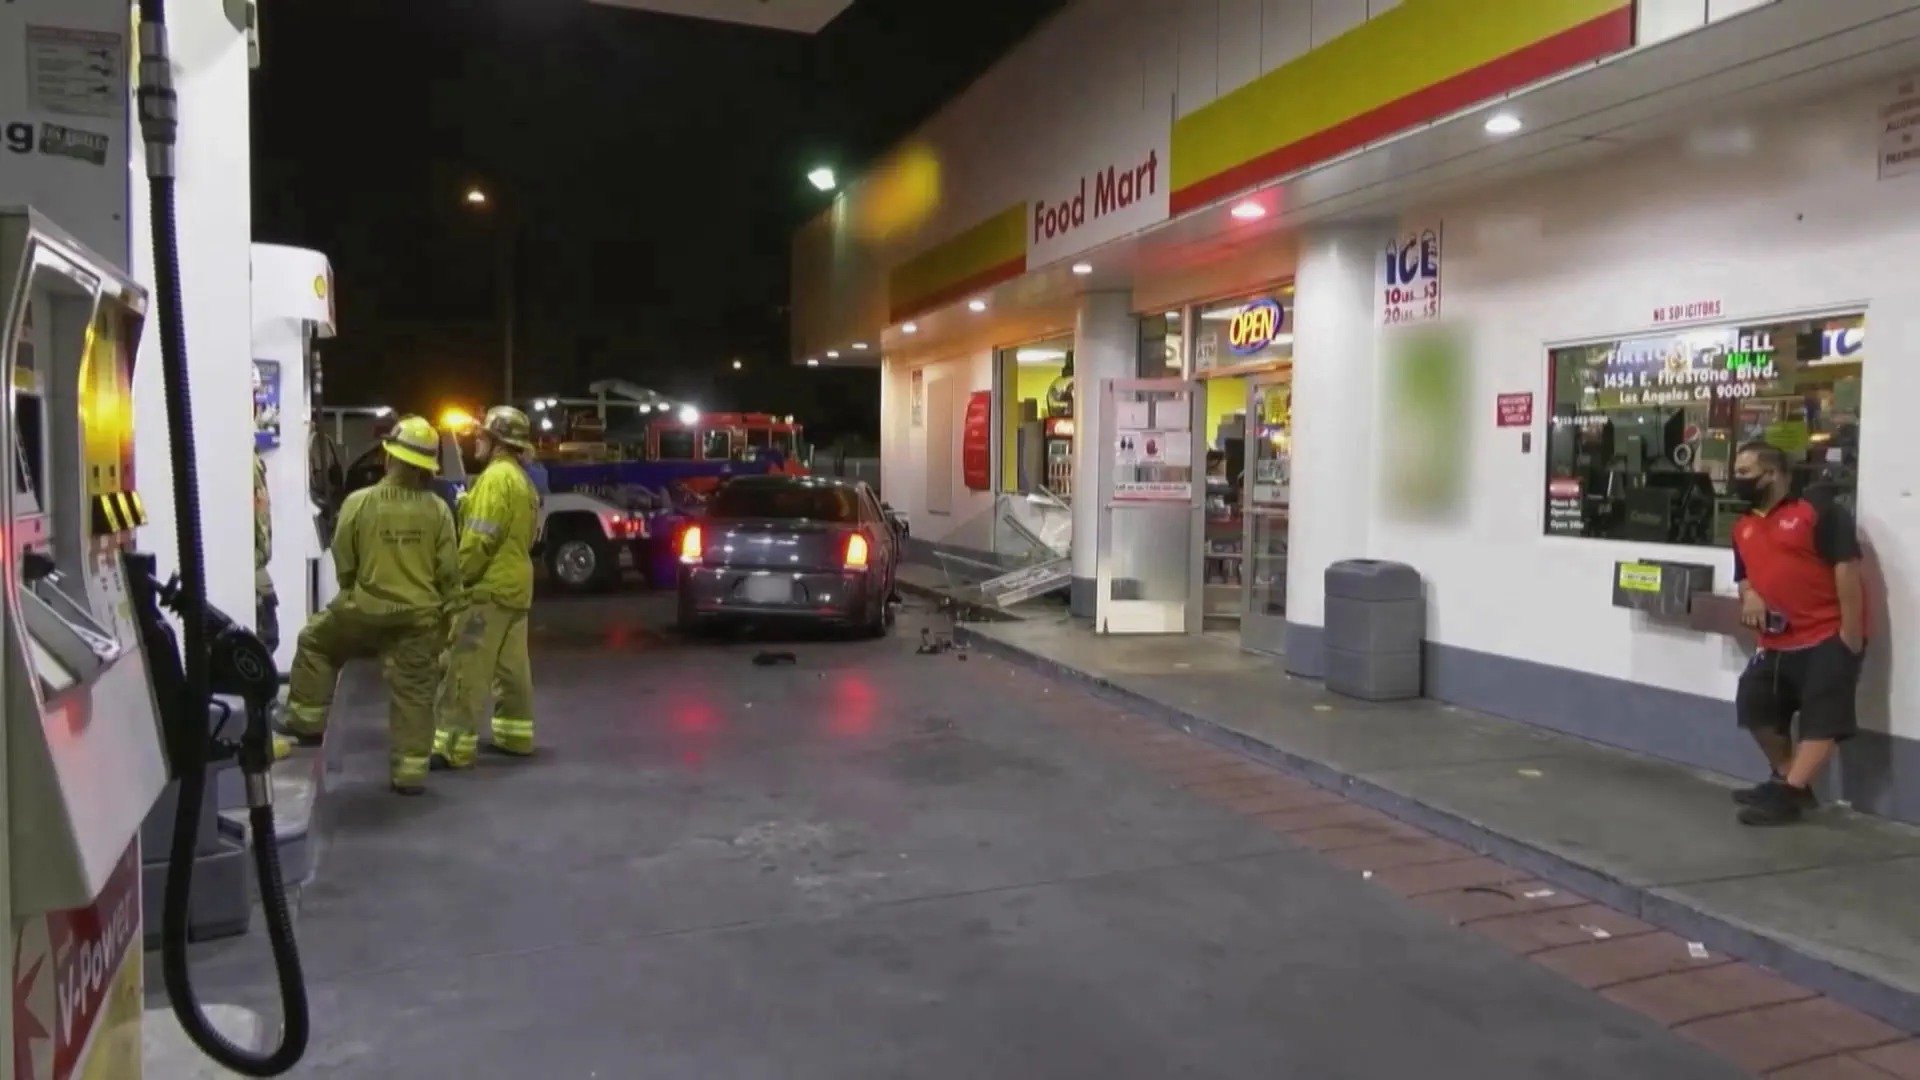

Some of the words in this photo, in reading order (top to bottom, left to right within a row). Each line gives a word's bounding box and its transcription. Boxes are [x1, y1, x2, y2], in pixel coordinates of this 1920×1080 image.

[0, 121, 34, 154] g
[1034, 176, 1085, 244] Food
[1094, 149, 1157, 219] Mart
[1385, 229, 1437, 284] ICE
[1229, 306, 1275, 346] OPEN
[1654, 307, 1665, 321] NO
[1669, 299, 1721, 320] SOLICITORS
[1604, 371, 1633, 389] 1454
[1640, 371, 1652, 387] E.
[1658, 366, 1729, 387] Firestone
[1737, 359, 1779, 381] Blvd.
[1619, 390, 1638, 404] Los
[1642, 386, 1689, 403] Angeles
[1694, 385, 1712, 400] CA
[1716, 382, 1757, 399] 90001
